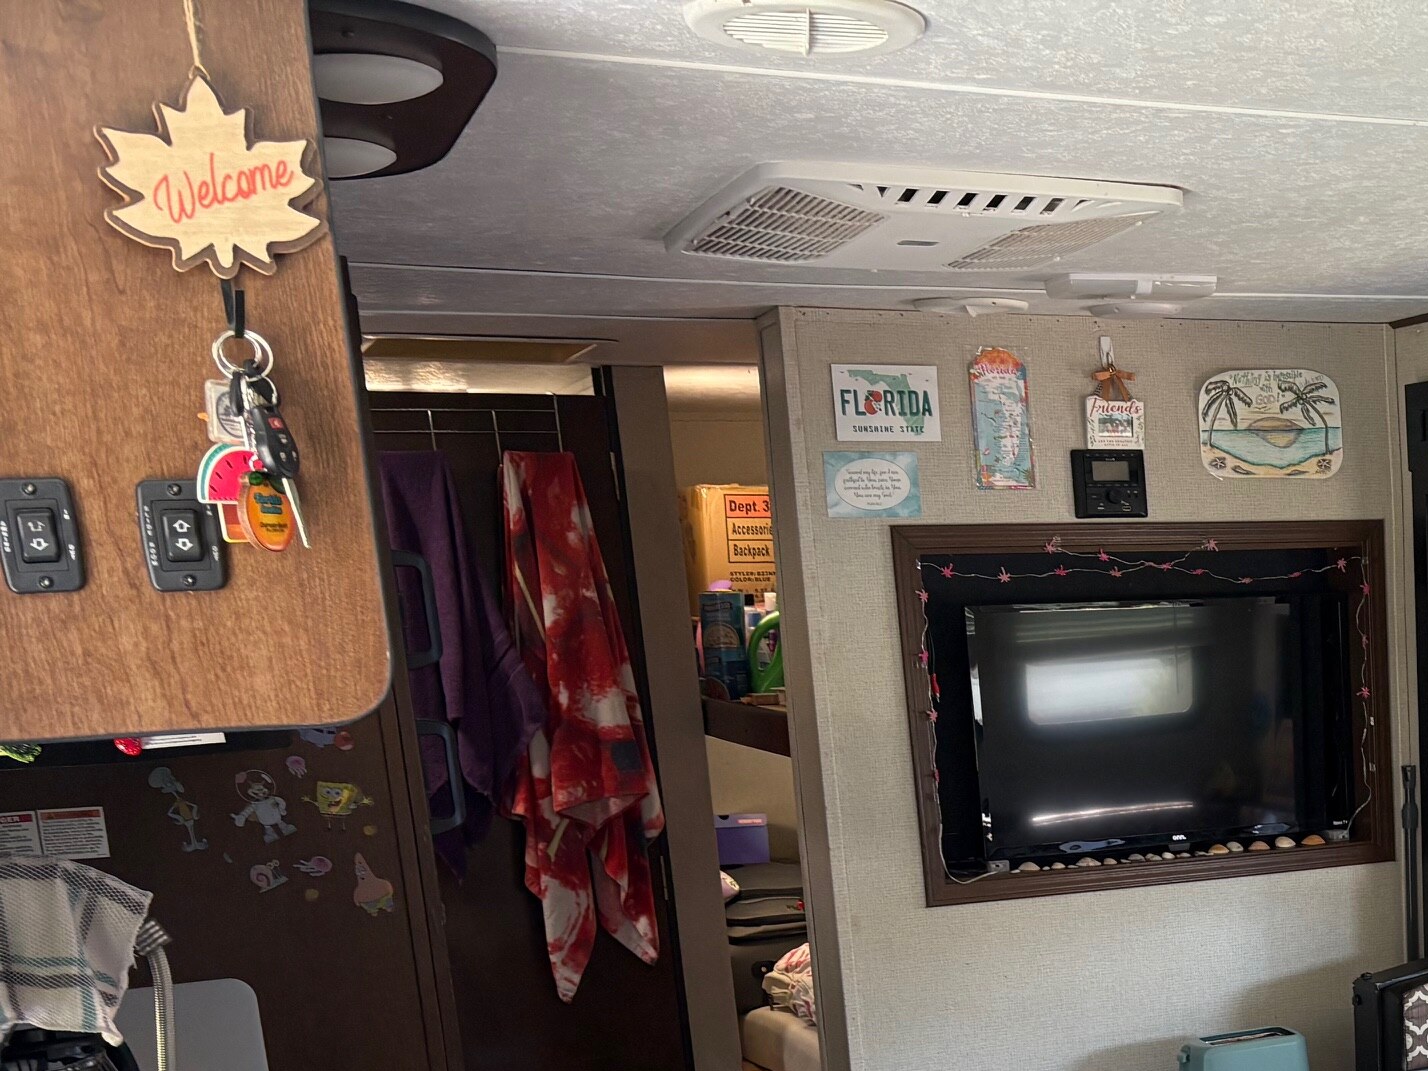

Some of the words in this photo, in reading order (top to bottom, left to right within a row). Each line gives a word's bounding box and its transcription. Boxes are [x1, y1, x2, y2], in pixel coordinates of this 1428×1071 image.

[153, 152, 294, 224] Welcome
[1087, 397, 1142, 418] Friends
[852, 425, 894, 434] SUNSHINE
[900, 425, 925, 434] STATE
[729, 500, 760, 515] Dept.
[734, 544, 770, 559] Backpack
